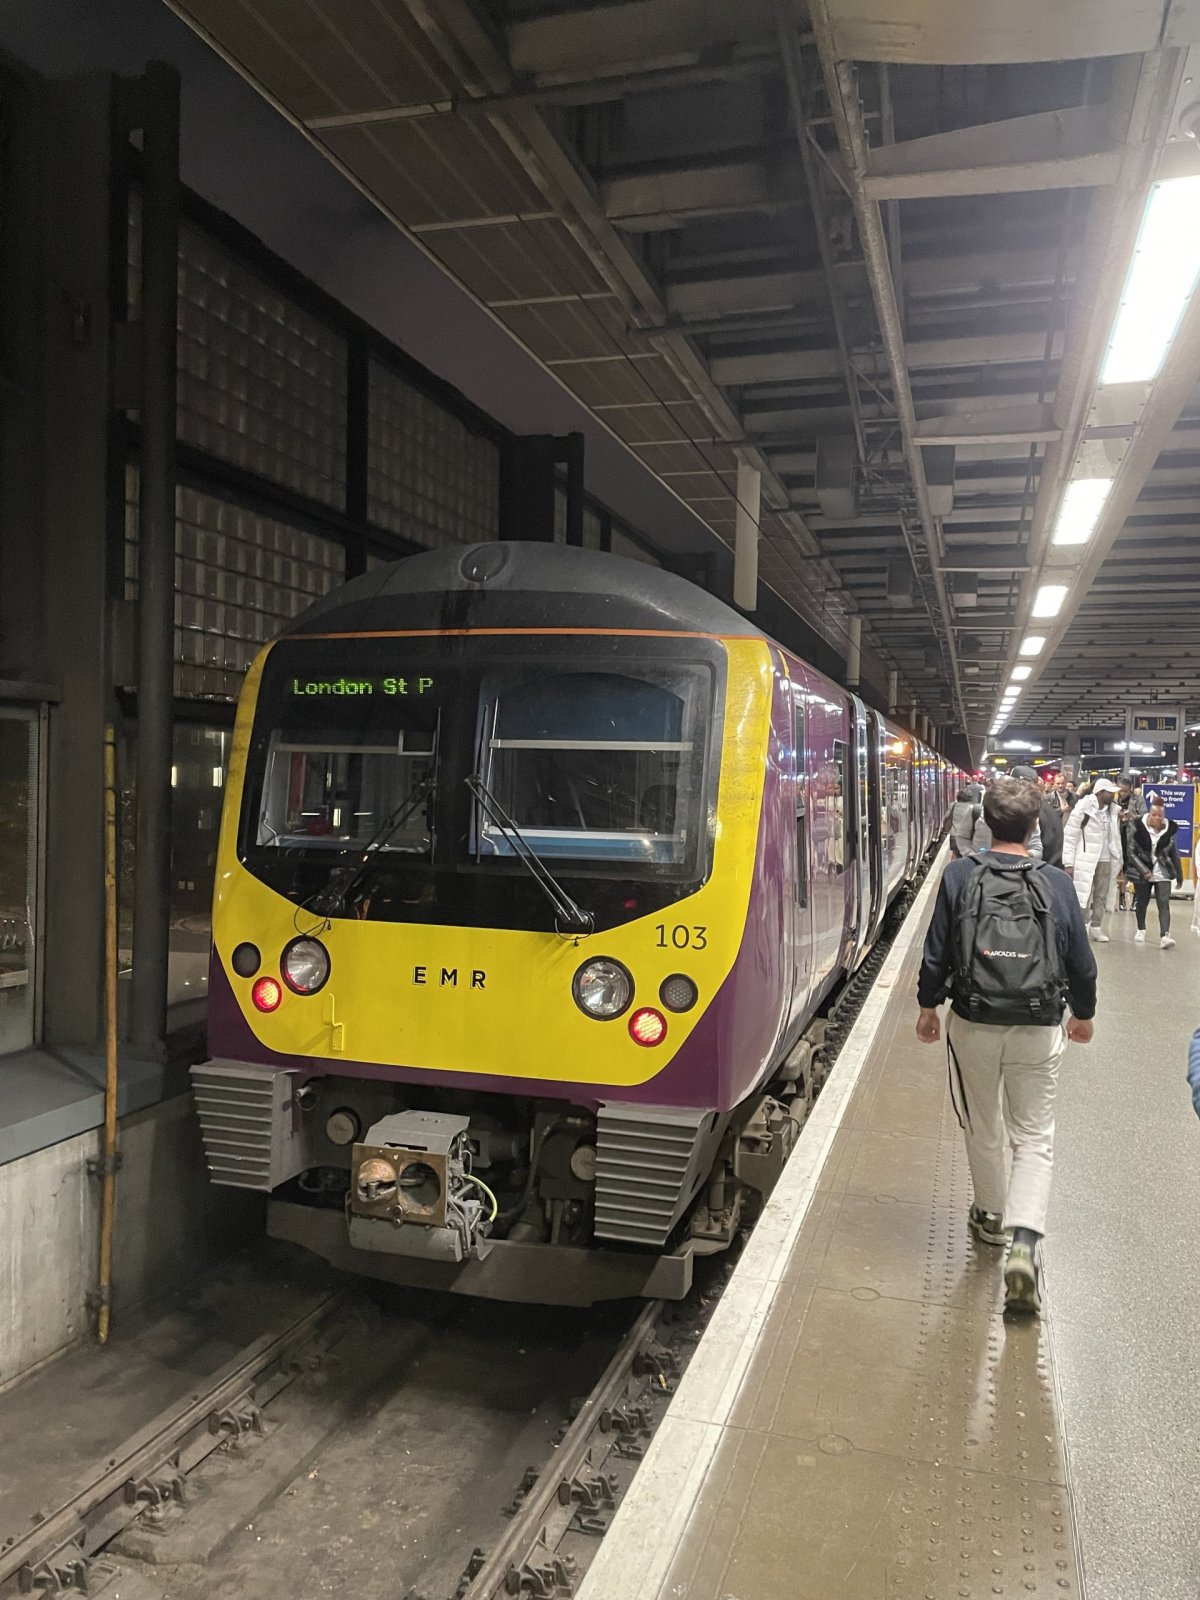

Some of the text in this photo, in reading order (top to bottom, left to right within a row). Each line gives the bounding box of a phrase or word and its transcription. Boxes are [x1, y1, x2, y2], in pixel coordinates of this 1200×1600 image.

[293, 677, 434, 694] London St P
[655, 924, 707, 950] 103
[413, 966, 486, 989] EMR
